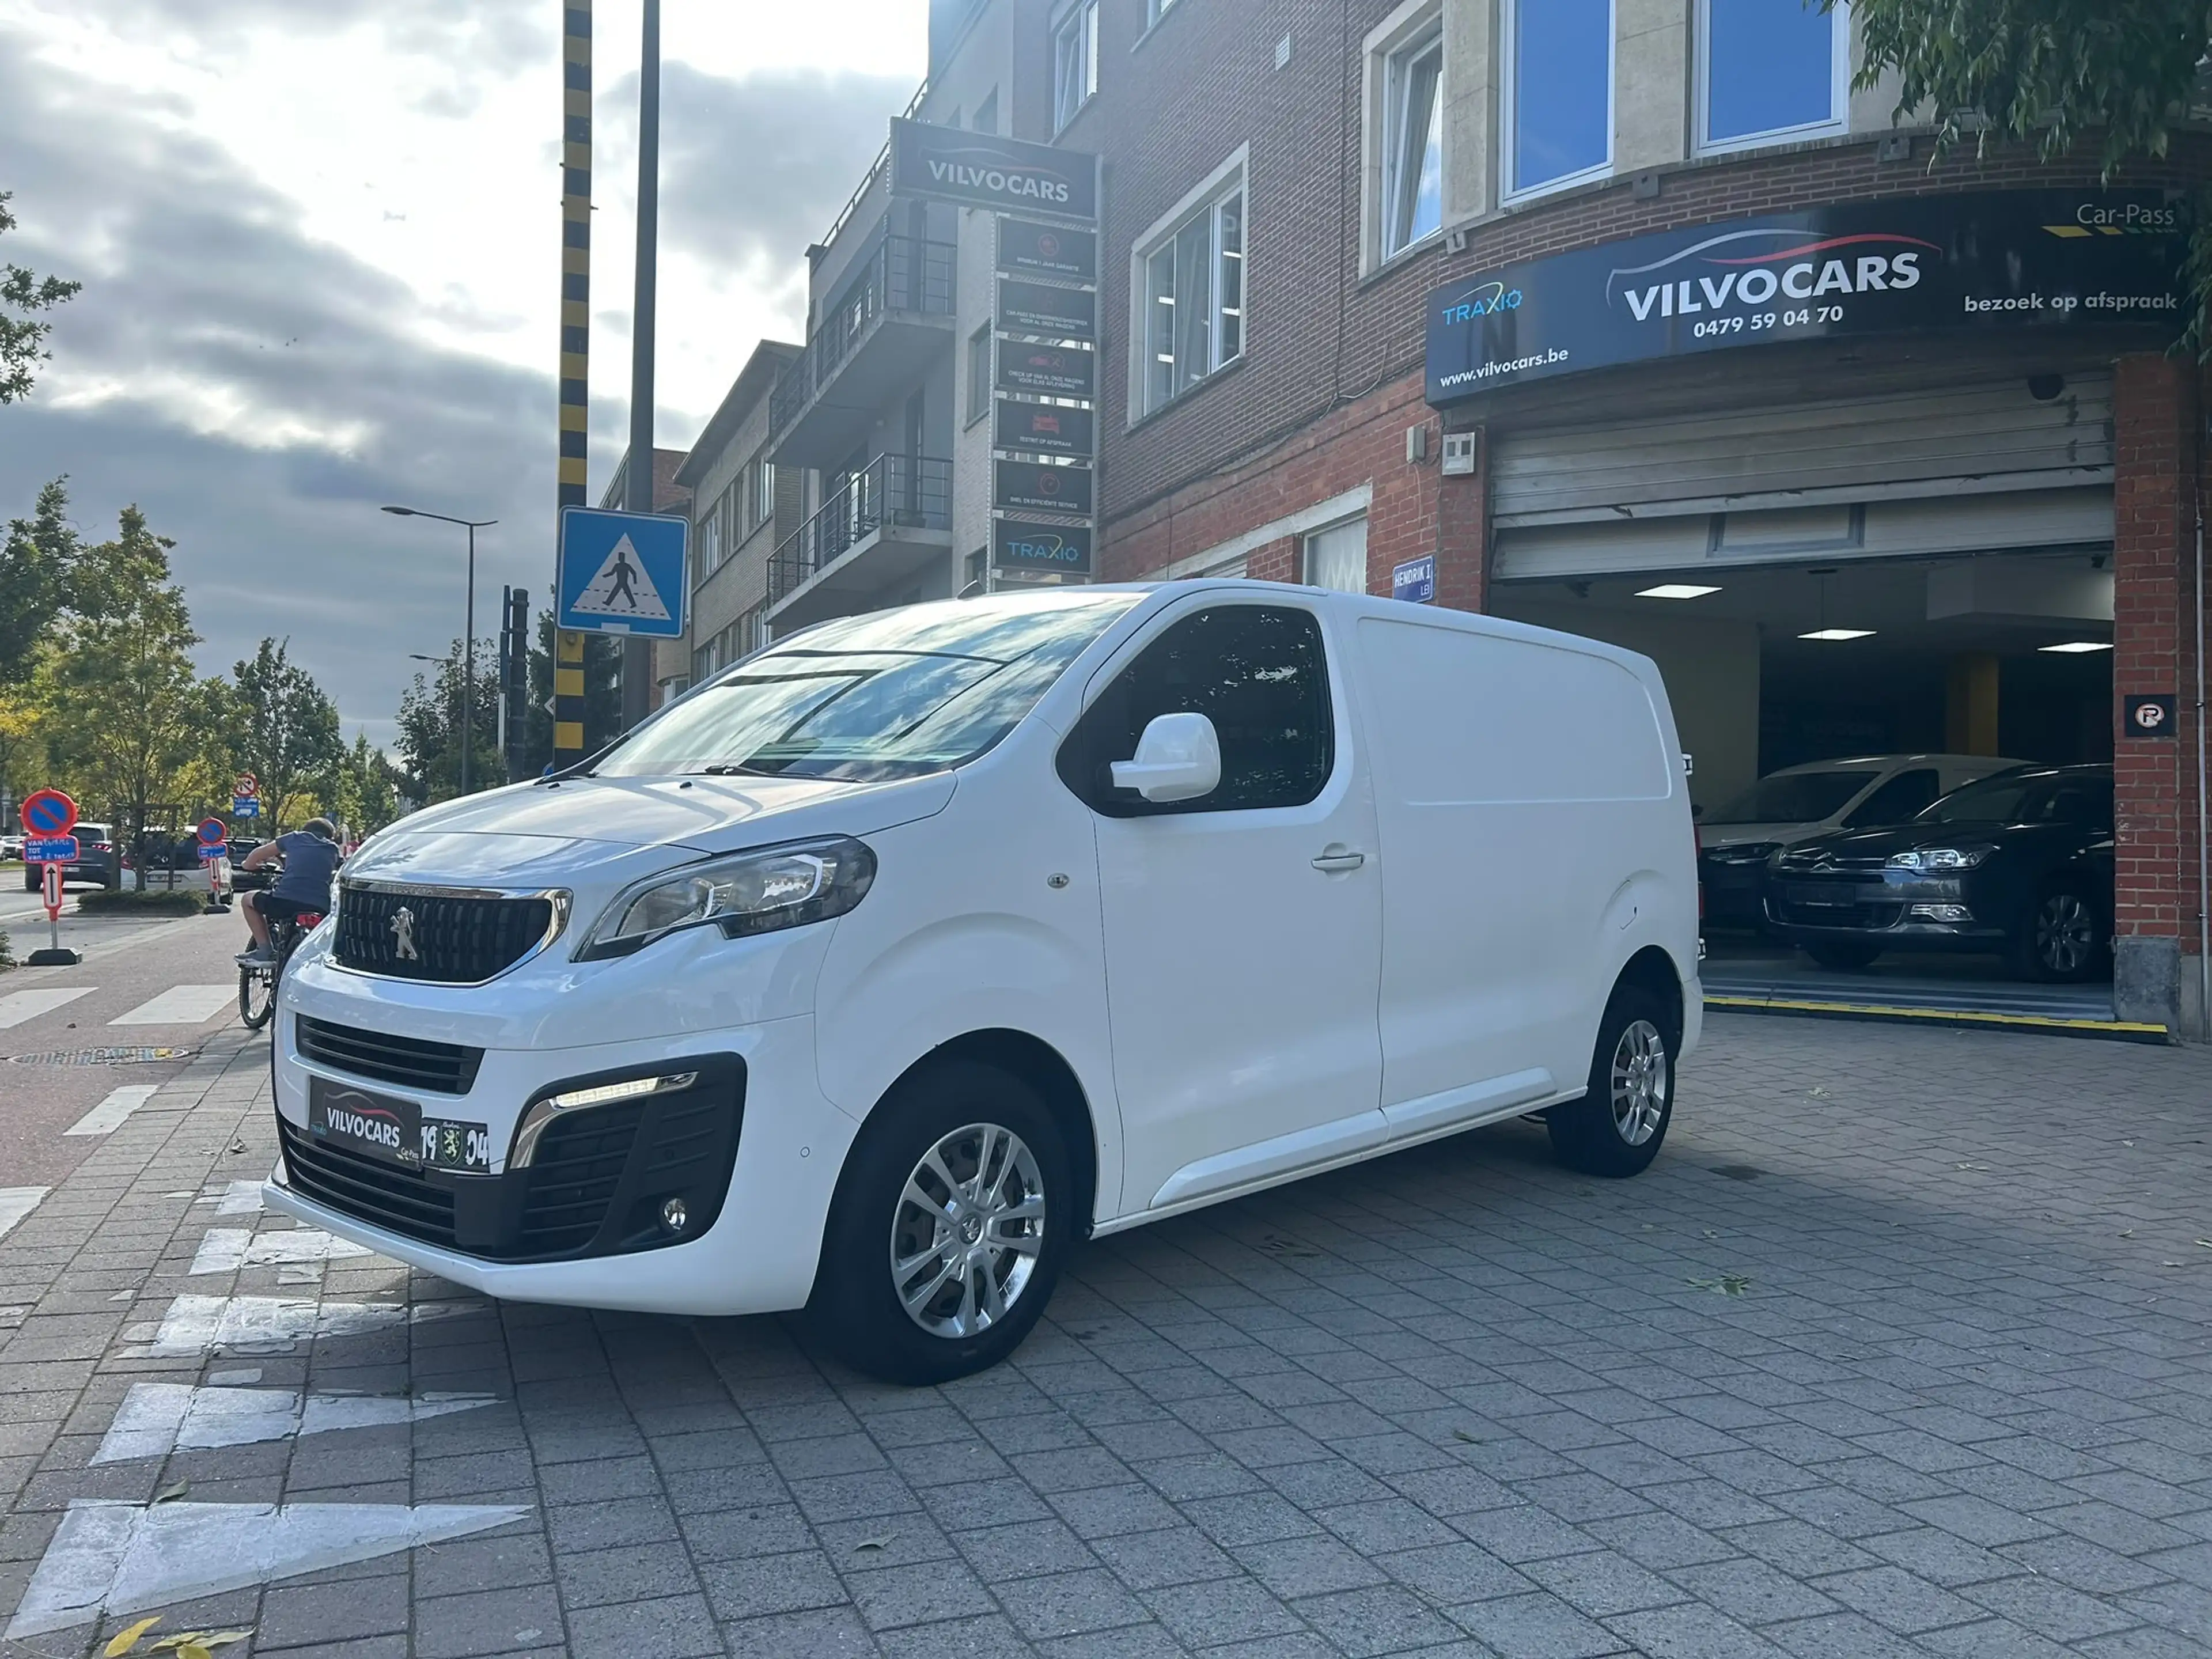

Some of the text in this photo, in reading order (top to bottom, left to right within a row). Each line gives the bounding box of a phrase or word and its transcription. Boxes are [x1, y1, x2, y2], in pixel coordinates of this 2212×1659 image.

[927, 160, 1069, 202] VILVOCARS
[2075, 203, 2176, 225] Car-Pass
[1623, 252, 1921, 323] VILVOCARS
[1964, 291, 2177, 313] bezoek op afspraak
[1442, 287, 1524, 326] TRAXIO
[1693, 305, 1843, 338] 0479 59 04 70
[1440, 347, 1569, 388] www.vilvocars.be
[1007, 540, 1078, 562] TRAXIO
[1394, 565, 1425, 588] HENDRIK
[327, 1106, 400, 1149] VILVOCARS
